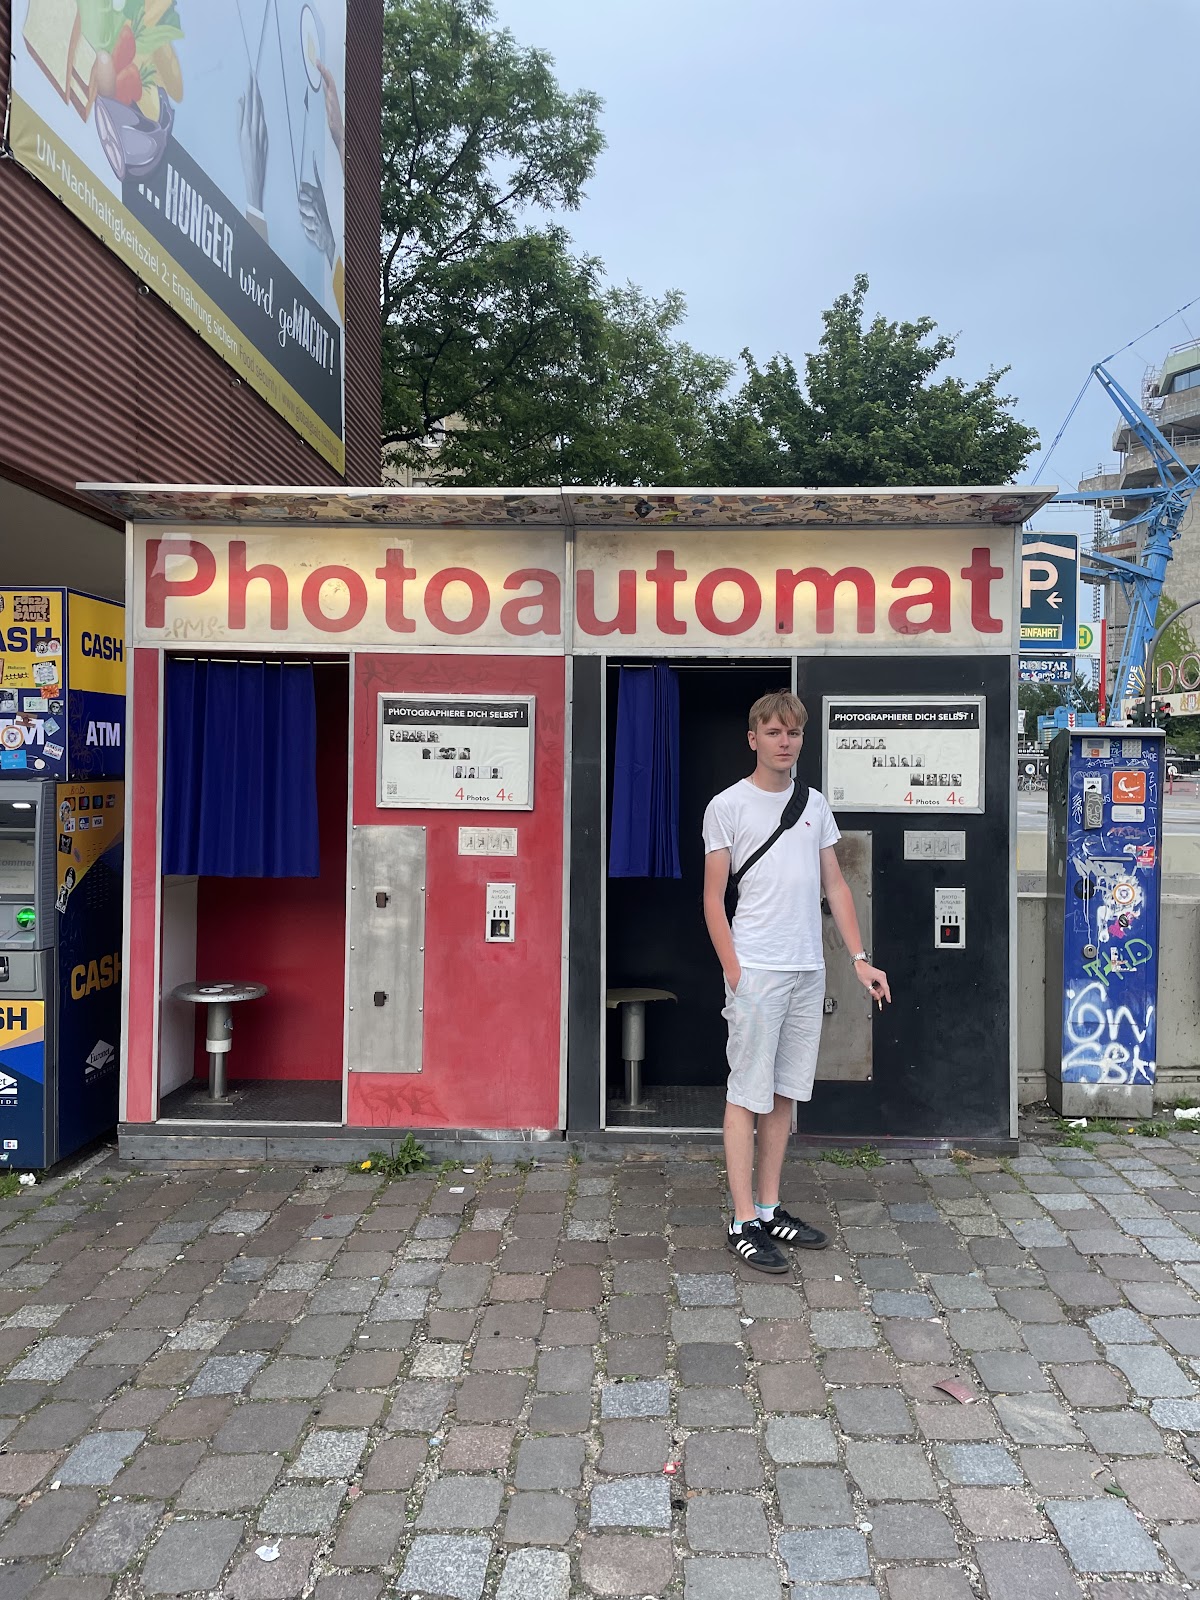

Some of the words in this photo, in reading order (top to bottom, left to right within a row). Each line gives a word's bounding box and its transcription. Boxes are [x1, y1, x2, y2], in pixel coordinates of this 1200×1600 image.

[36, 134, 159, 276] UN-Nachhaltigkeitsziel
[161, 263, 170, 287] 2:
[172, 273, 212, 334] Ernährung
[213, 319, 238, 355] sichern
[165, 163, 233, 279] HUNGER
[240, 267, 274, 318] wird
[145, 539, 1003, 637] Photoautomat
[1022, 560, 1059, 608] P
[1021, 628, 1058, 638] EINFAHRT
[81, 631, 123, 662] CASH
[388, 708, 465, 718] PHOTOGRAPHIERE
[467, 710, 488, 718] DICH
[489, 710, 518, 719] SELBST
[834, 713, 913, 721] PHOTOGRAPHIERE
[914, 713, 936, 721] DICH
[938, 712, 969, 721] SELBST
[86, 721, 121, 746] ATM
[455, 787, 465, 801] 4
[466, 794, 490, 802] Photos
[903, 791, 914, 805] 4
